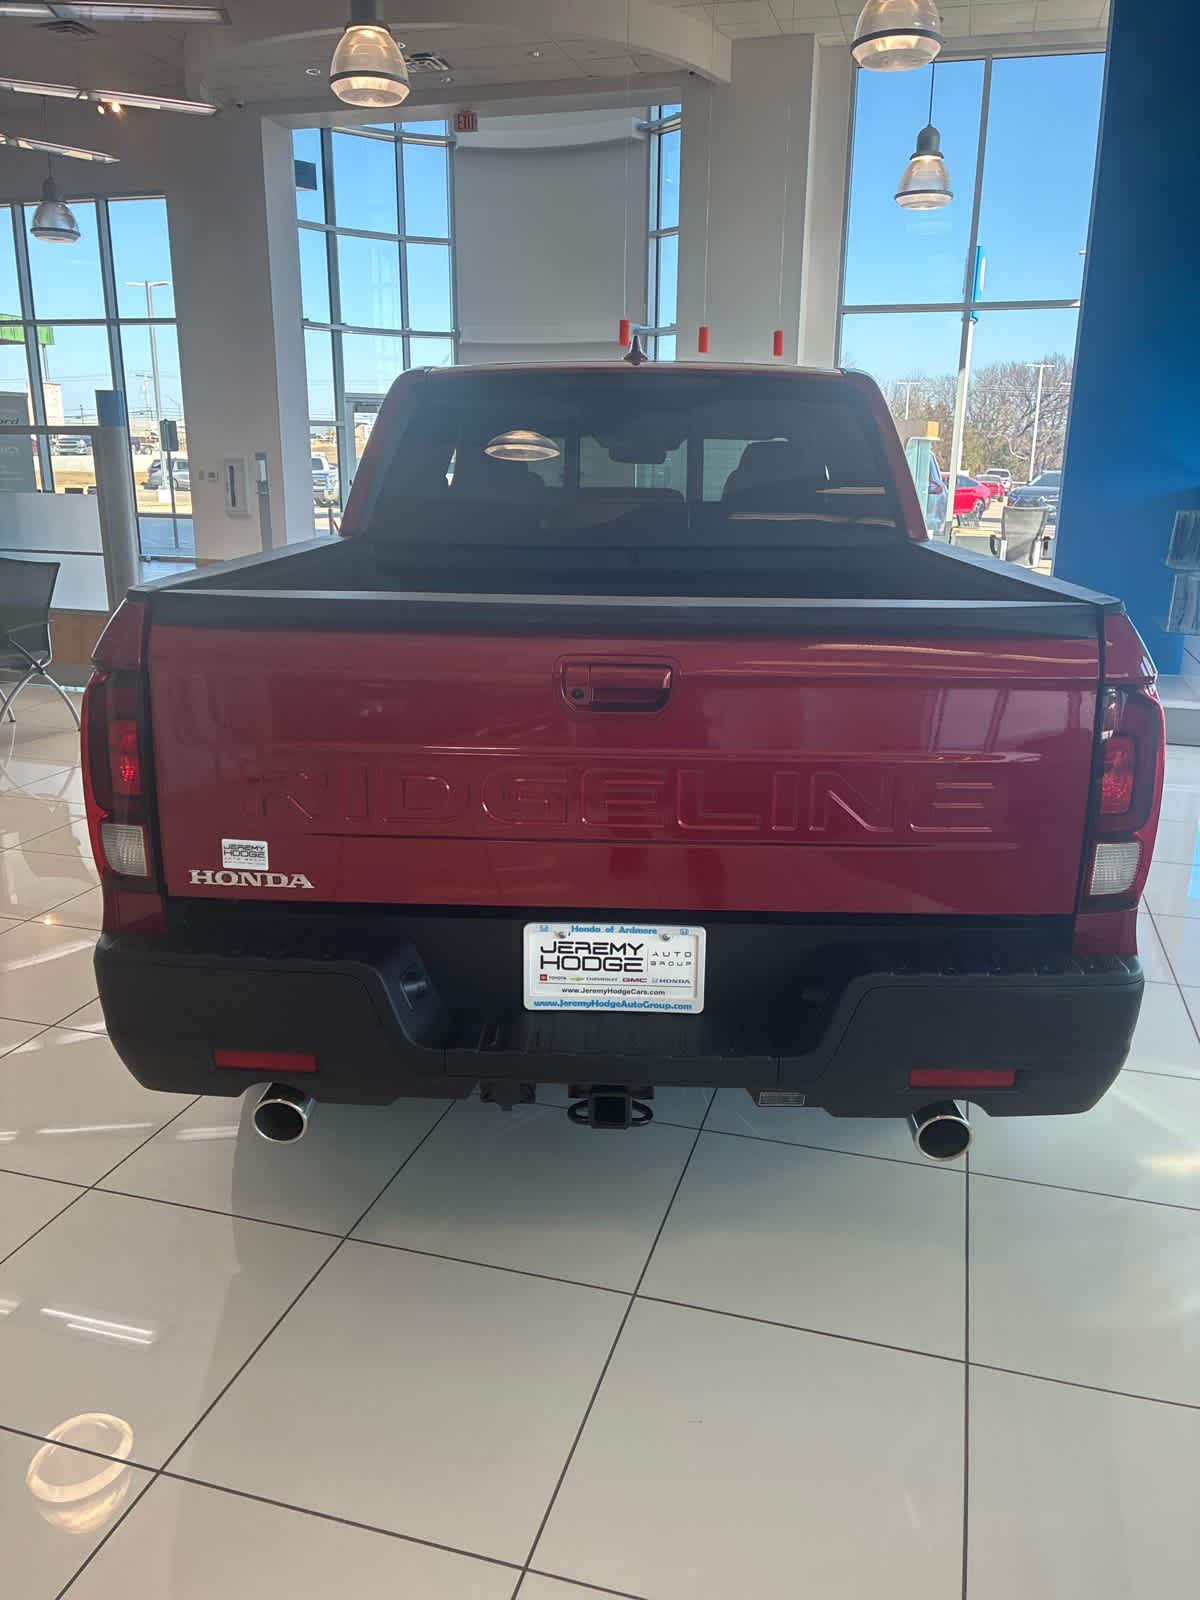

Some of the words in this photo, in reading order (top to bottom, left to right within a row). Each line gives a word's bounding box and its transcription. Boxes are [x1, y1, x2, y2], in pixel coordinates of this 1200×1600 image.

[239, 762, 997, 832] RIDGELINE
[223, 844, 265, 852] JEREMY
[223, 849, 265, 858] HODGE
[188, 869, 315, 889] HONDA
[571, 925, 601, 934] Honda
[605, 926, 615, 934] of
[619, 926, 658, 935] Ardmore
[540, 941, 645, 956] JEREMY
[540, 955, 644, 973] HODGE
[562, 986, 666, 996] www.JeremyHodgeCars.com
[534, 1000, 693, 1011] www.JeremyHodgeAutoGroup.com
